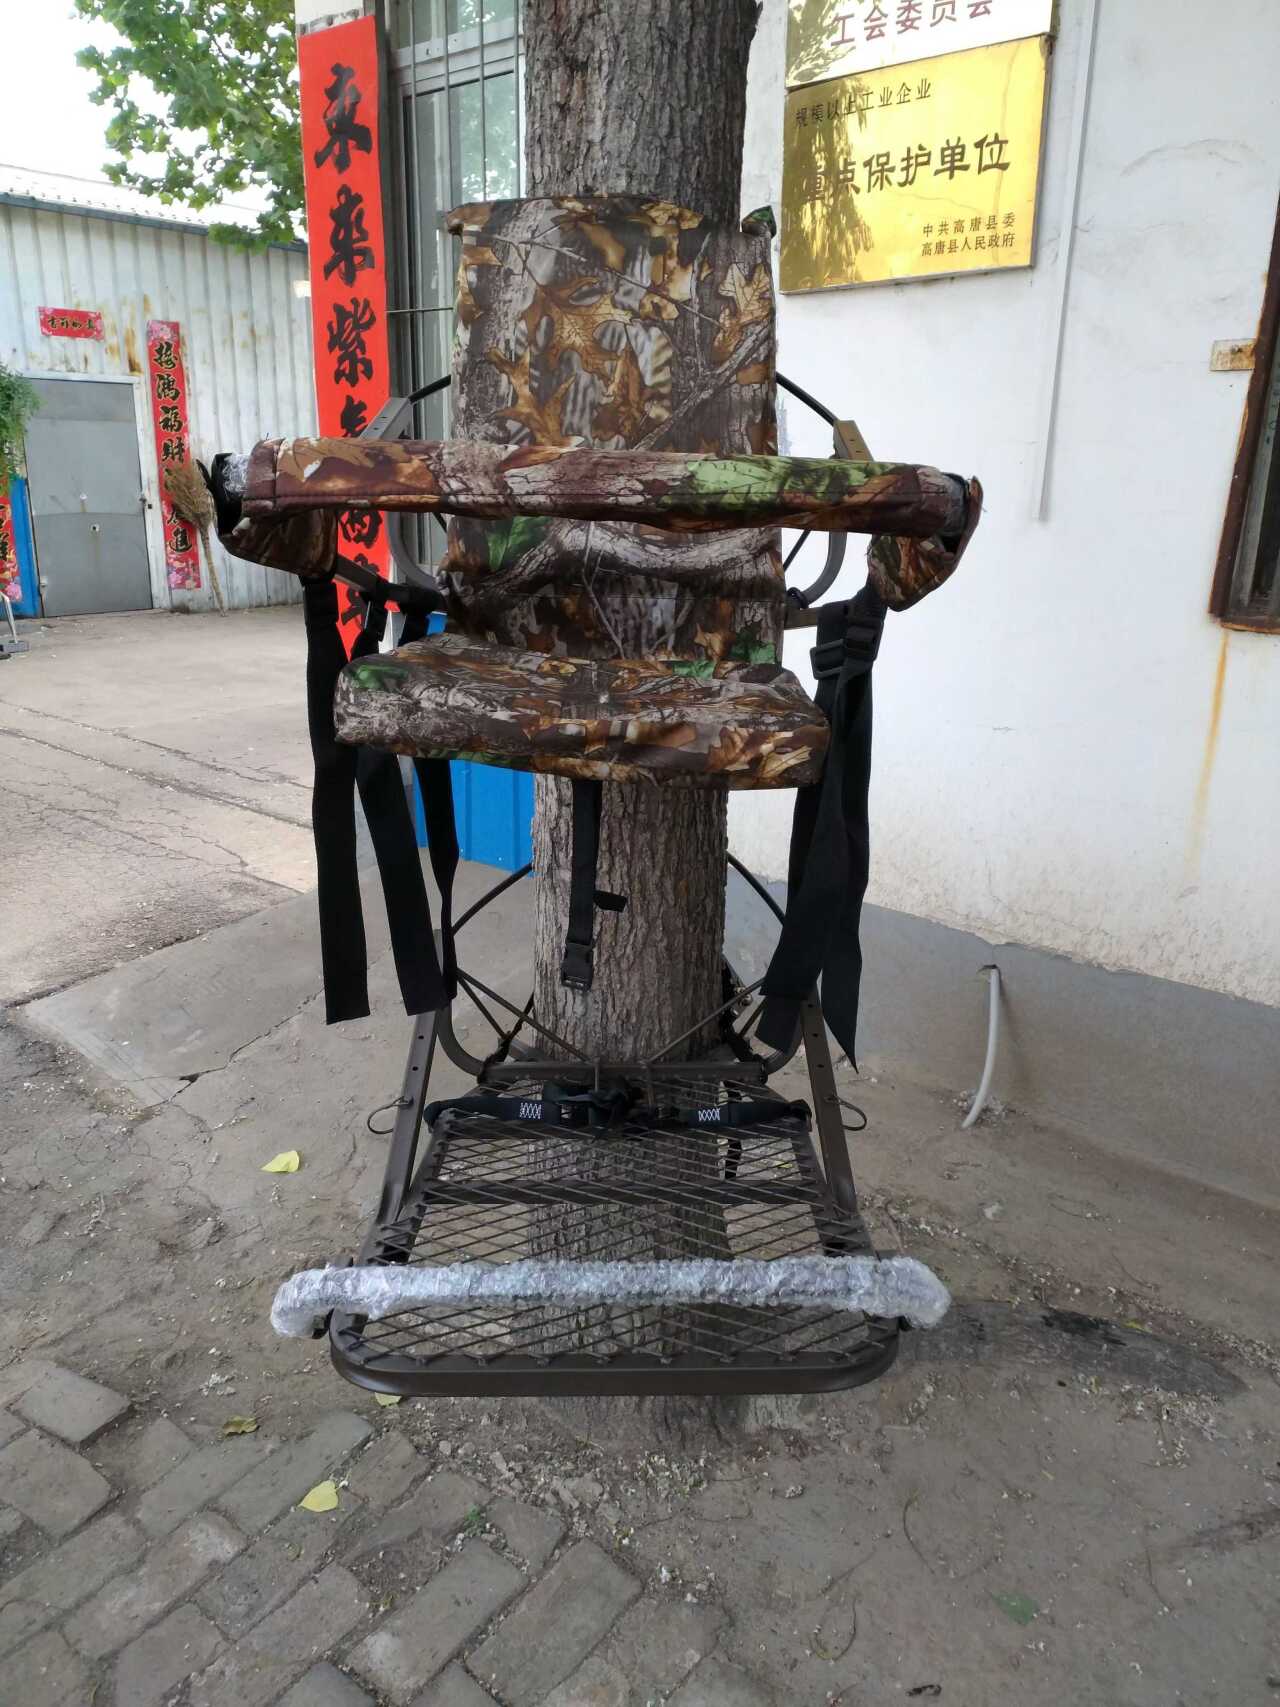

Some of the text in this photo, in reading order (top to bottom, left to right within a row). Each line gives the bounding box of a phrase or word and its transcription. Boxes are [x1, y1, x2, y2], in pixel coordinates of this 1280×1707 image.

[795, 78, 932, 128] 规模以上工业企业
[921, 232, 1016, 257] 高唐县人民政府
